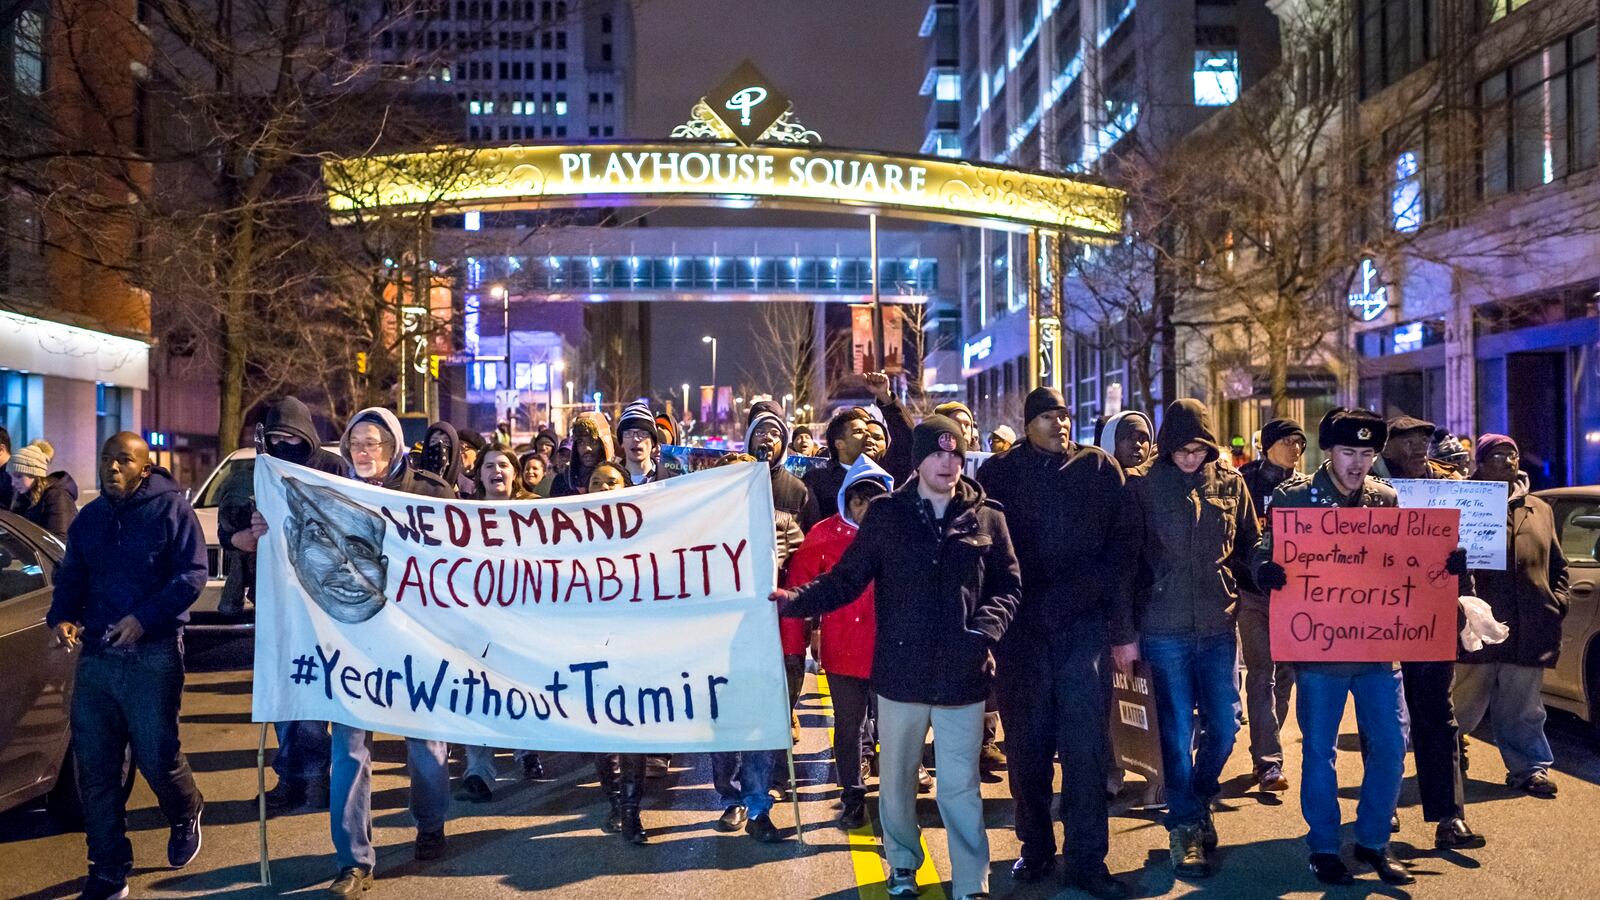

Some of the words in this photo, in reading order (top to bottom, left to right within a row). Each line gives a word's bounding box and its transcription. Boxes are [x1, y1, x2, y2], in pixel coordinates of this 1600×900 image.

[560, 151, 775, 185] PLAYHOUSE
[789, 157, 927, 194] SQUARE
[1429, 485, 1442, 494] OF
[1276, 510, 1313, 534] The
[1320, 510, 1401, 536] Cleveland
[1406, 510, 1452, 537] Police
[1283, 540, 1368, 569] Department
[1383, 552, 1395, 568] is
[1406, 555, 1420, 568] a
[396, 539, 747, 608] ACCOUNTABILITY
[1296, 574, 1416, 607] Terrorist
[1290, 611, 1437, 651] Organization!
[290, 644, 729, 727] #YearWithoutTamir
[1112, 672, 1129, 690] LACK
[1131, 676, 1149, 696] LIVES
[1121, 703, 1145, 724] MATTER
